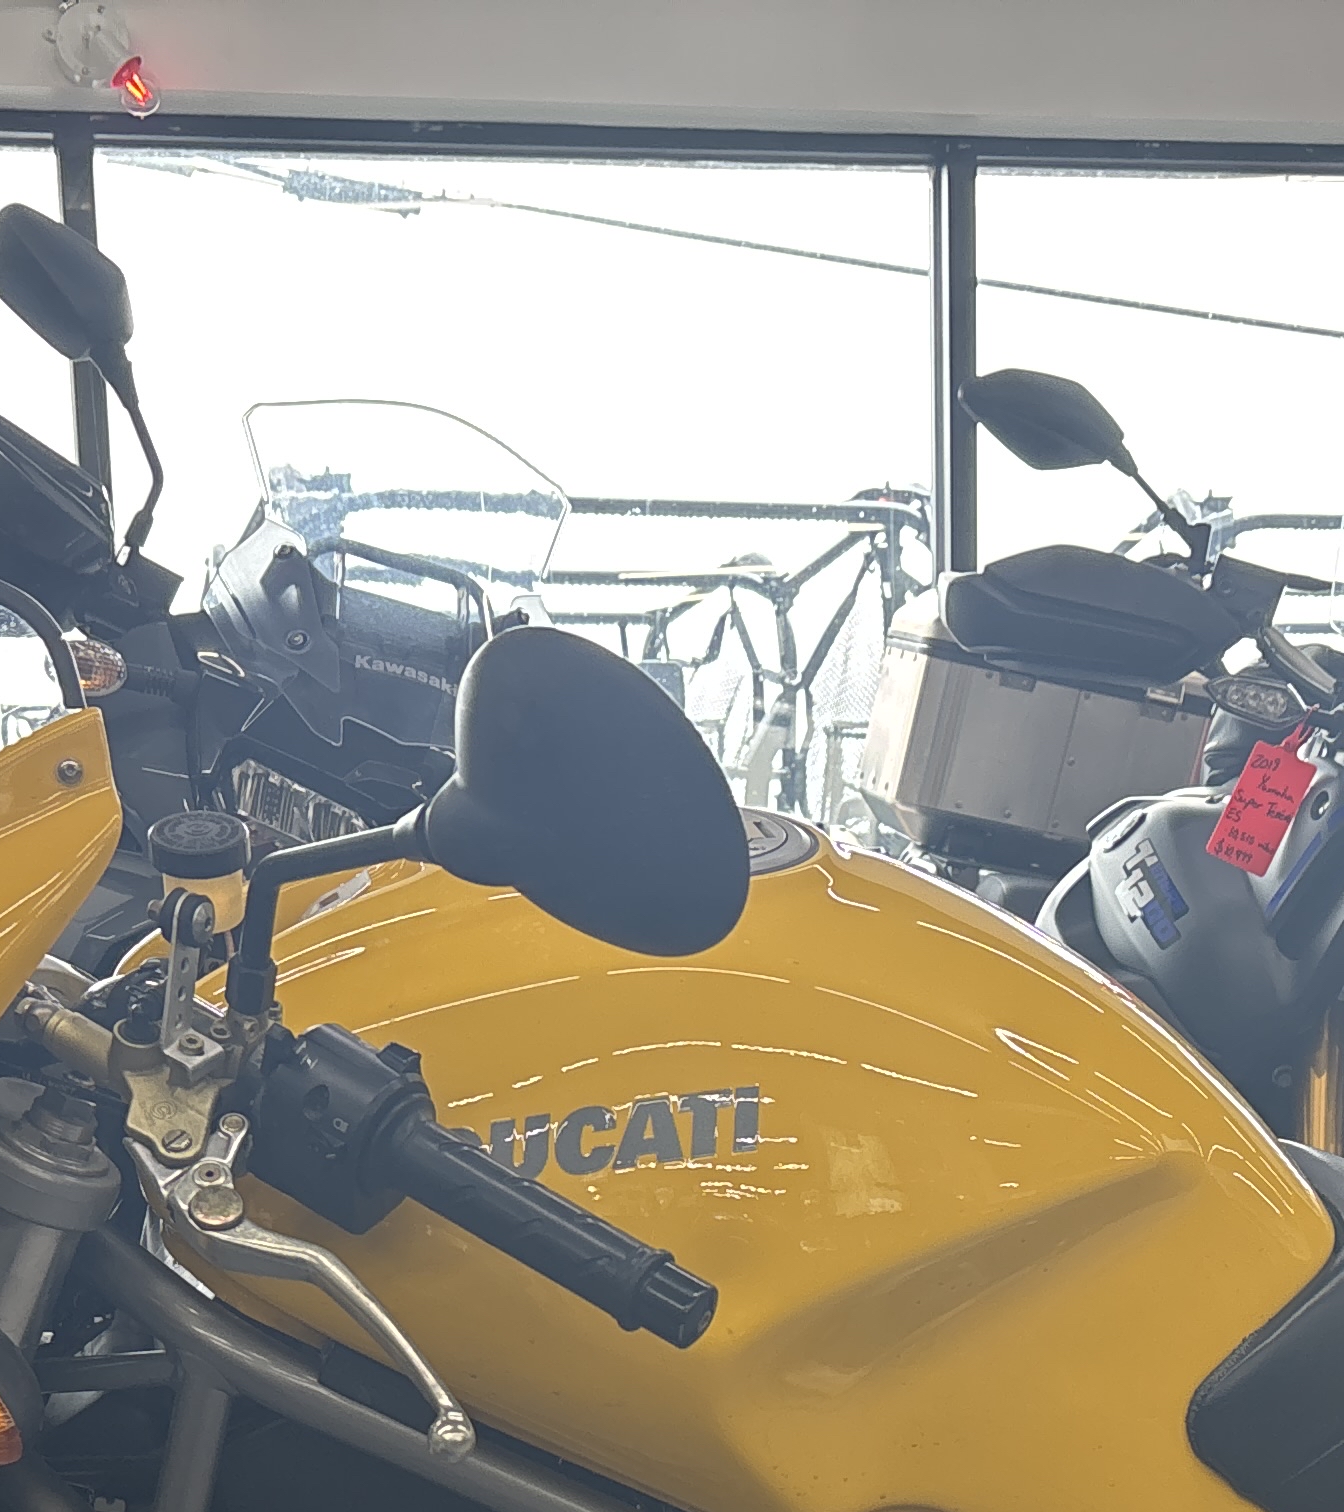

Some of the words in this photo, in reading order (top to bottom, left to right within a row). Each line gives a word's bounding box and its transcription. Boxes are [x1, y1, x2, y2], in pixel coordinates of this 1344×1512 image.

[355, 655, 458, 698] Kawasaki
[1233, 788, 1263, 810] Super
[1226, 808, 1241, 822] ES
